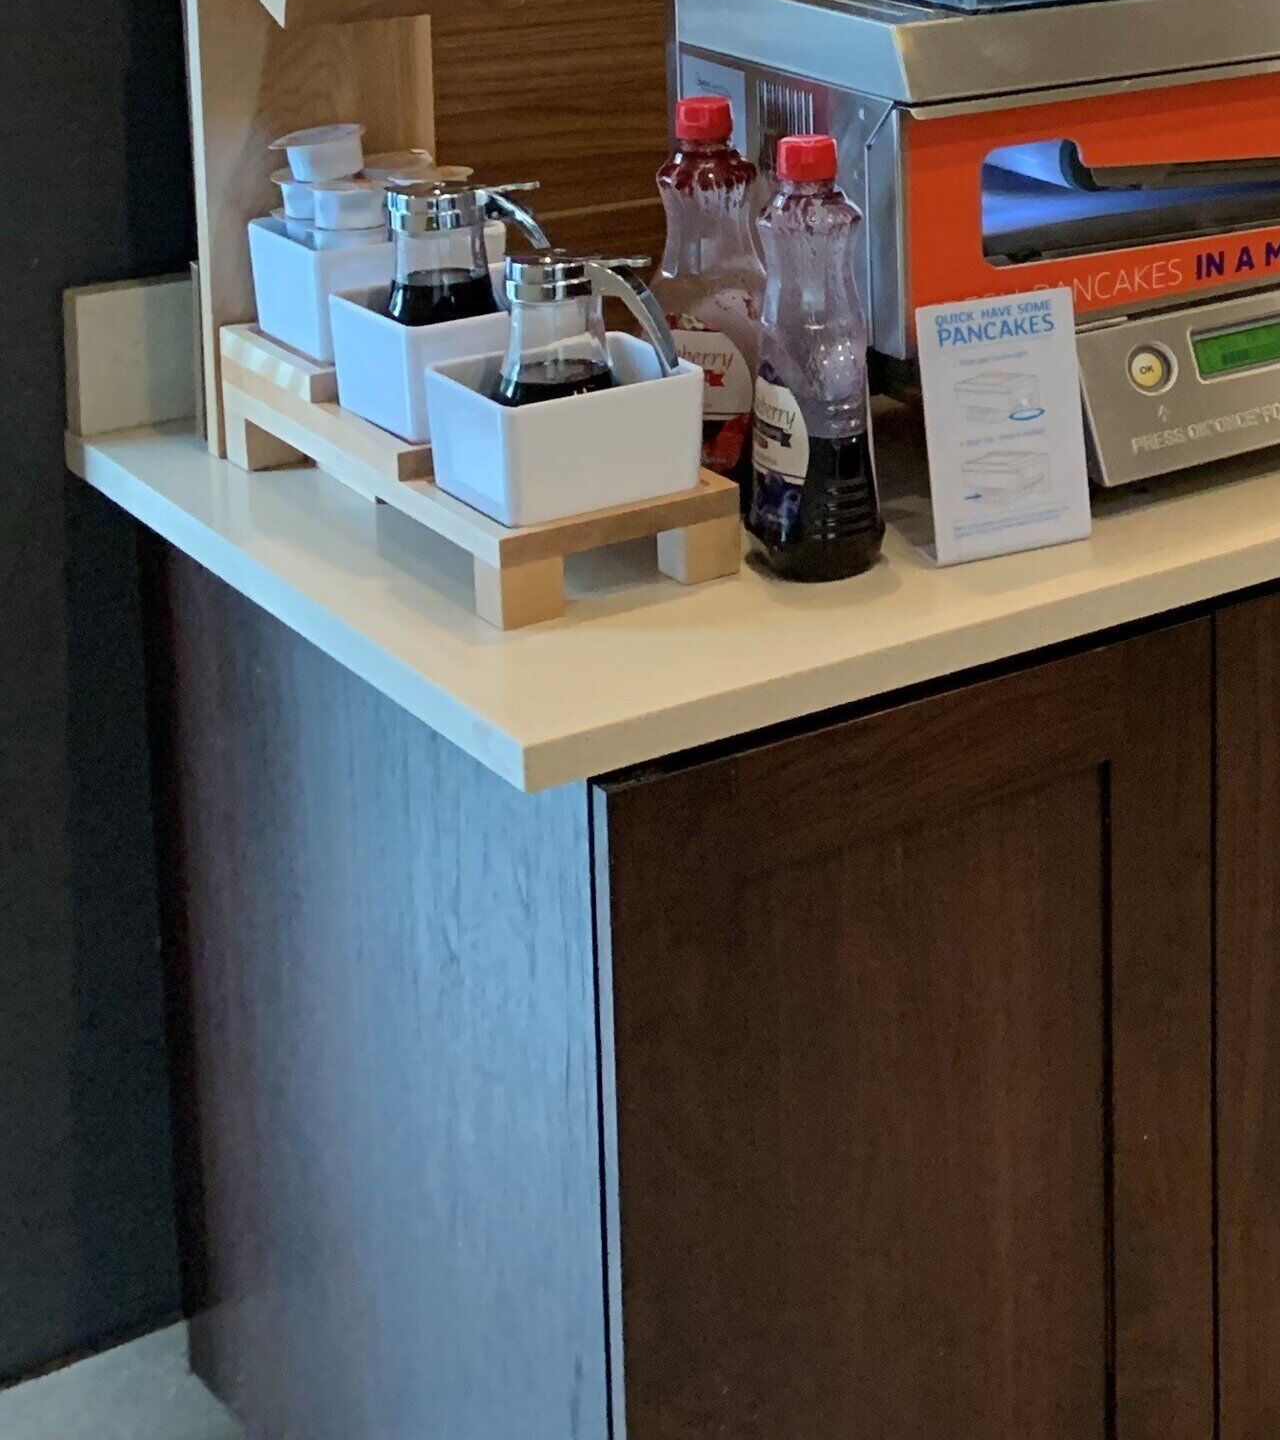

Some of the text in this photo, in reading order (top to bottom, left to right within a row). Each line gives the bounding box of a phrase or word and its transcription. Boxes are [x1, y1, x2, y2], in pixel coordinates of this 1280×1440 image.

[1195, 249, 1225, 281] IN
[1235, 245, 1255, 273] A
[935, 299, 1053, 328] QUICK HAVE SOME
[937, 313, 1055, 348] PANCAKES
[1139, 363, 1156, 376] OK
[1131, 426, 1187, 454] PRESS
